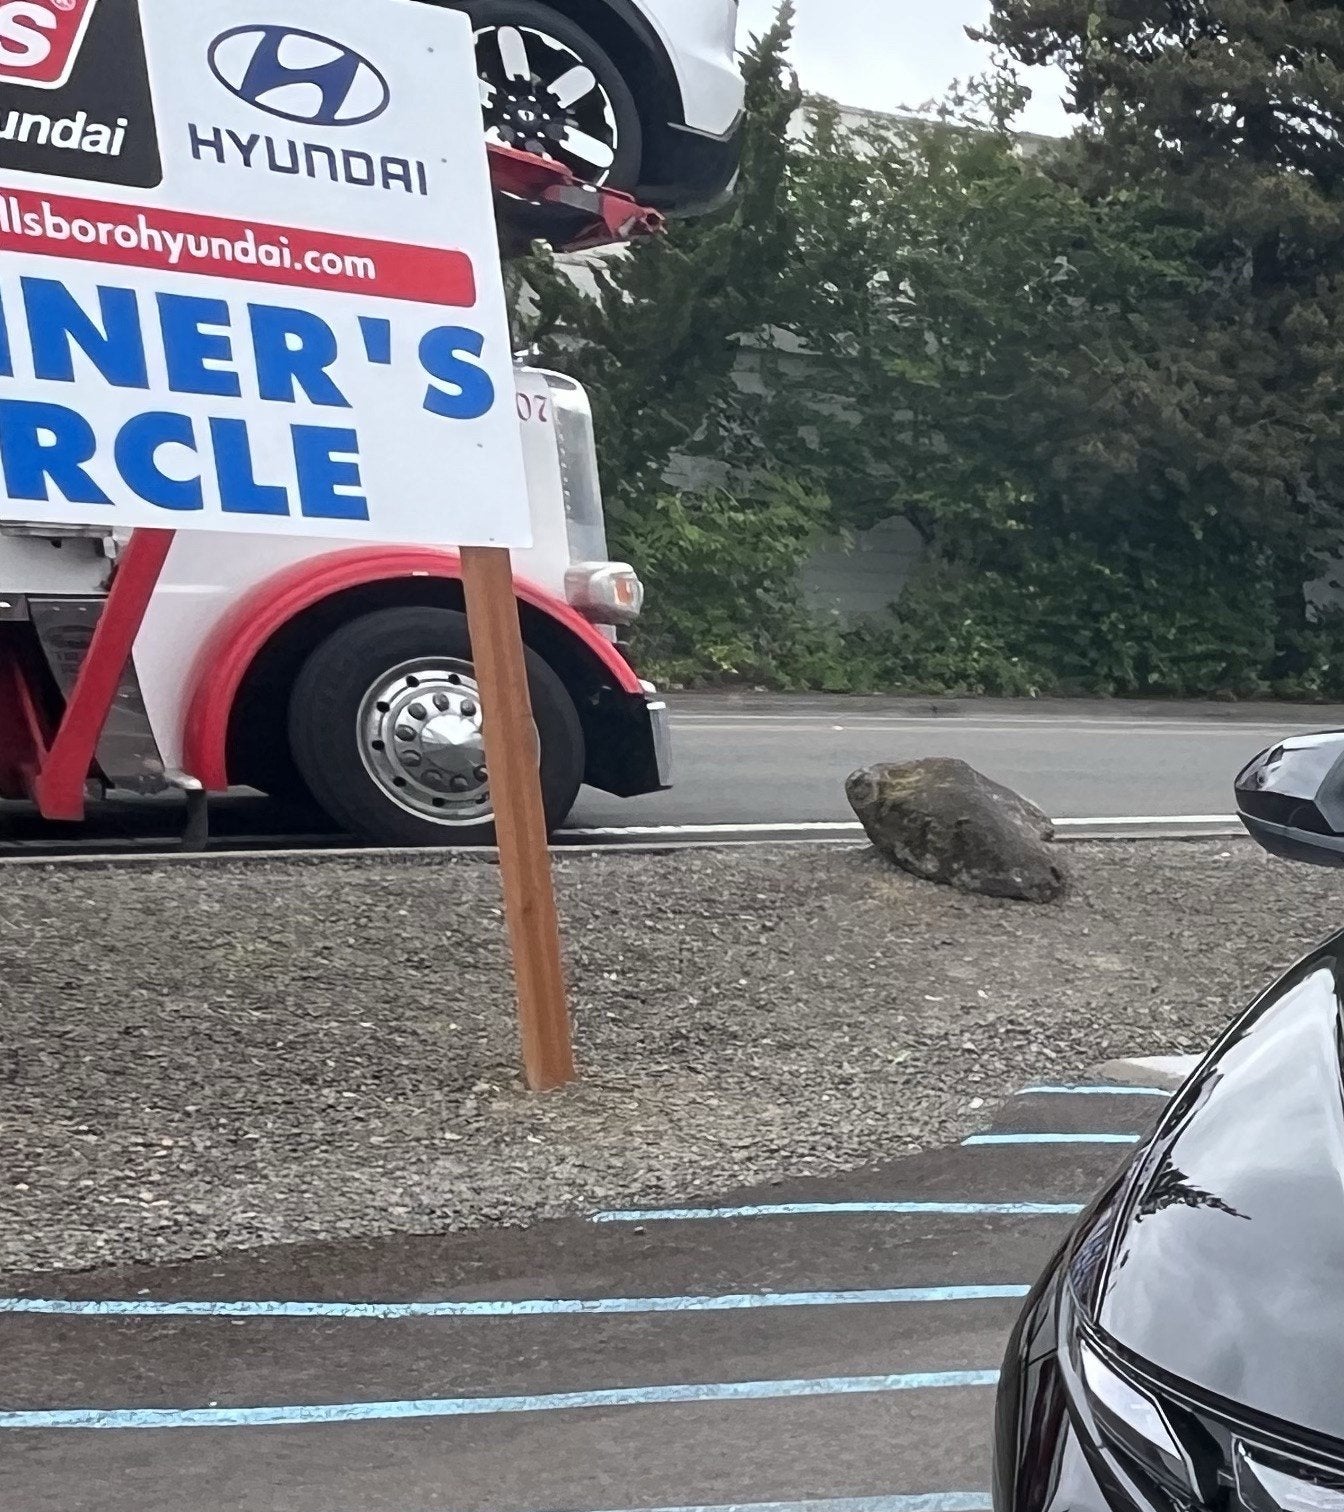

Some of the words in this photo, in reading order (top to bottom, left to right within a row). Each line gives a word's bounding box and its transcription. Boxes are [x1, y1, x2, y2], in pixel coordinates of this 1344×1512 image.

[188, 123, 427, 195] HYUNDAI
[0, 276, 494, 420] NER'S
[0, 399, 370, 521] RCLE
